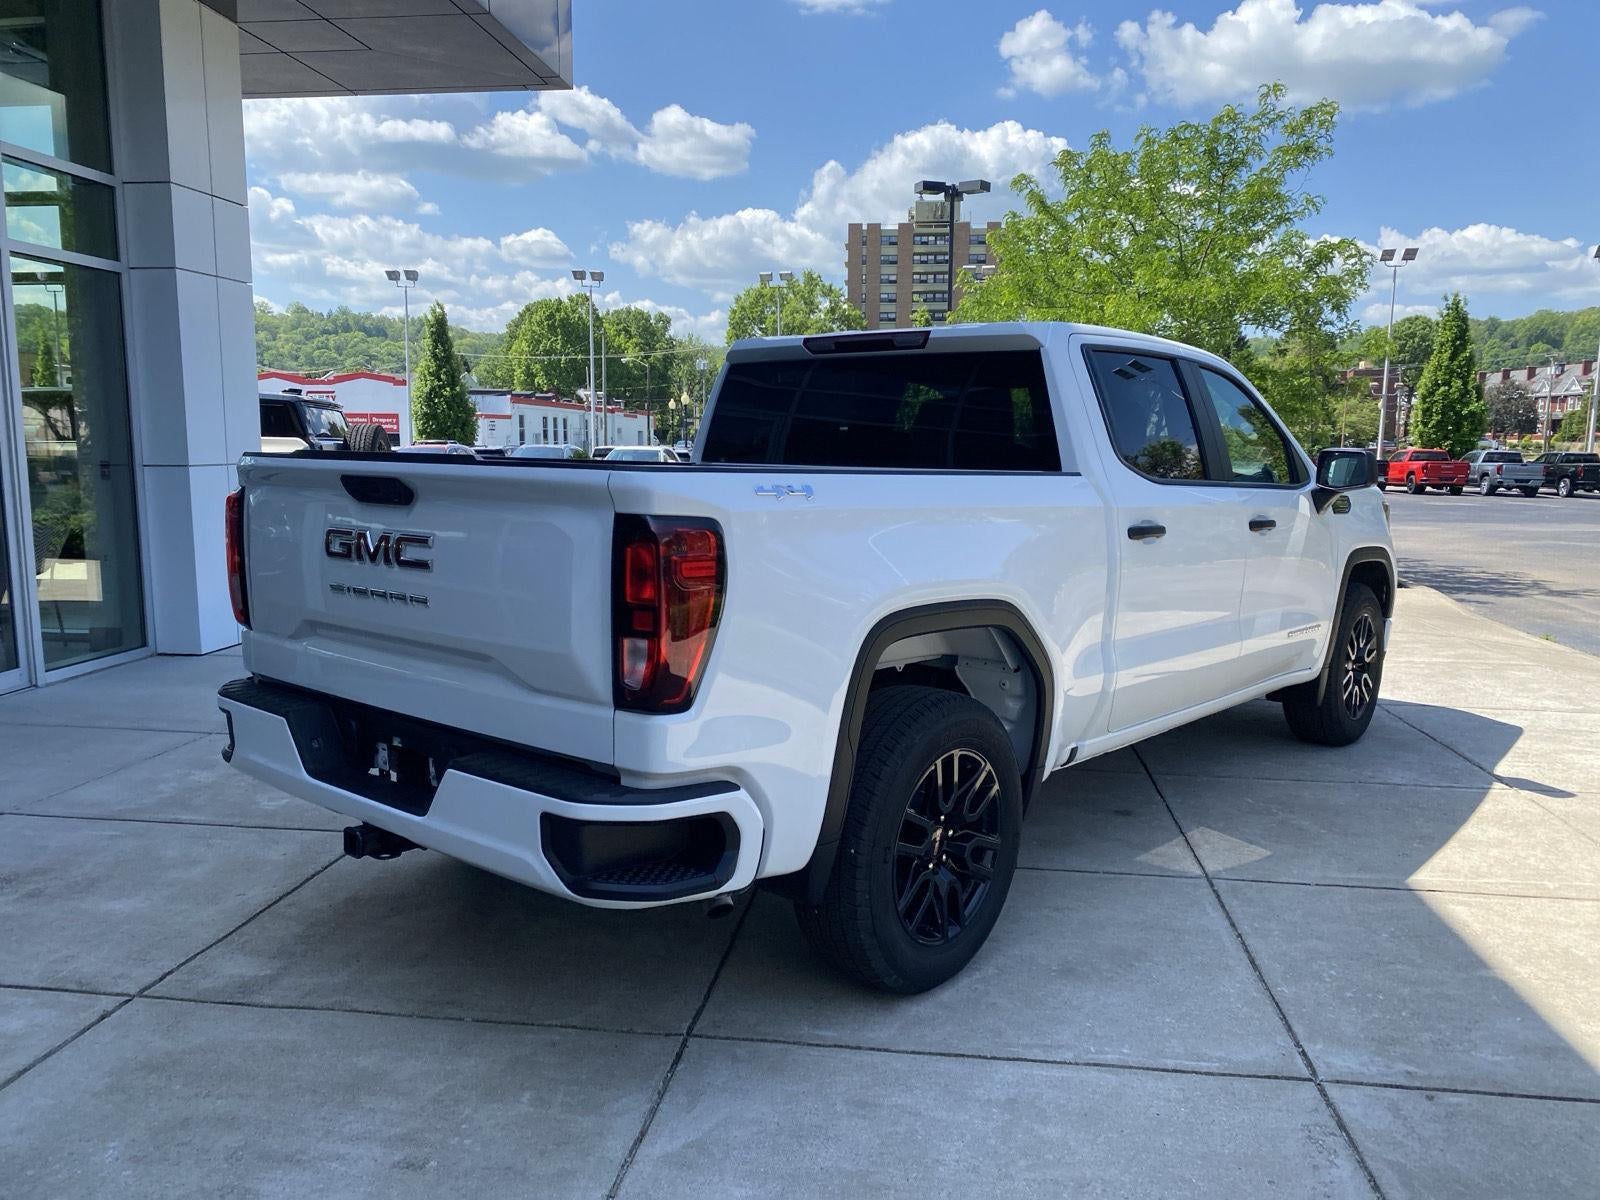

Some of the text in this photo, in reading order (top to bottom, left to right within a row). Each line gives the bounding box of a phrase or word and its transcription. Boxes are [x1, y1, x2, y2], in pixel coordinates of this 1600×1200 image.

[372, 416, 397, 424] Drapery
[325, 527, 434, 572] GMC
[328, 582, 430, 608] SIERRA
